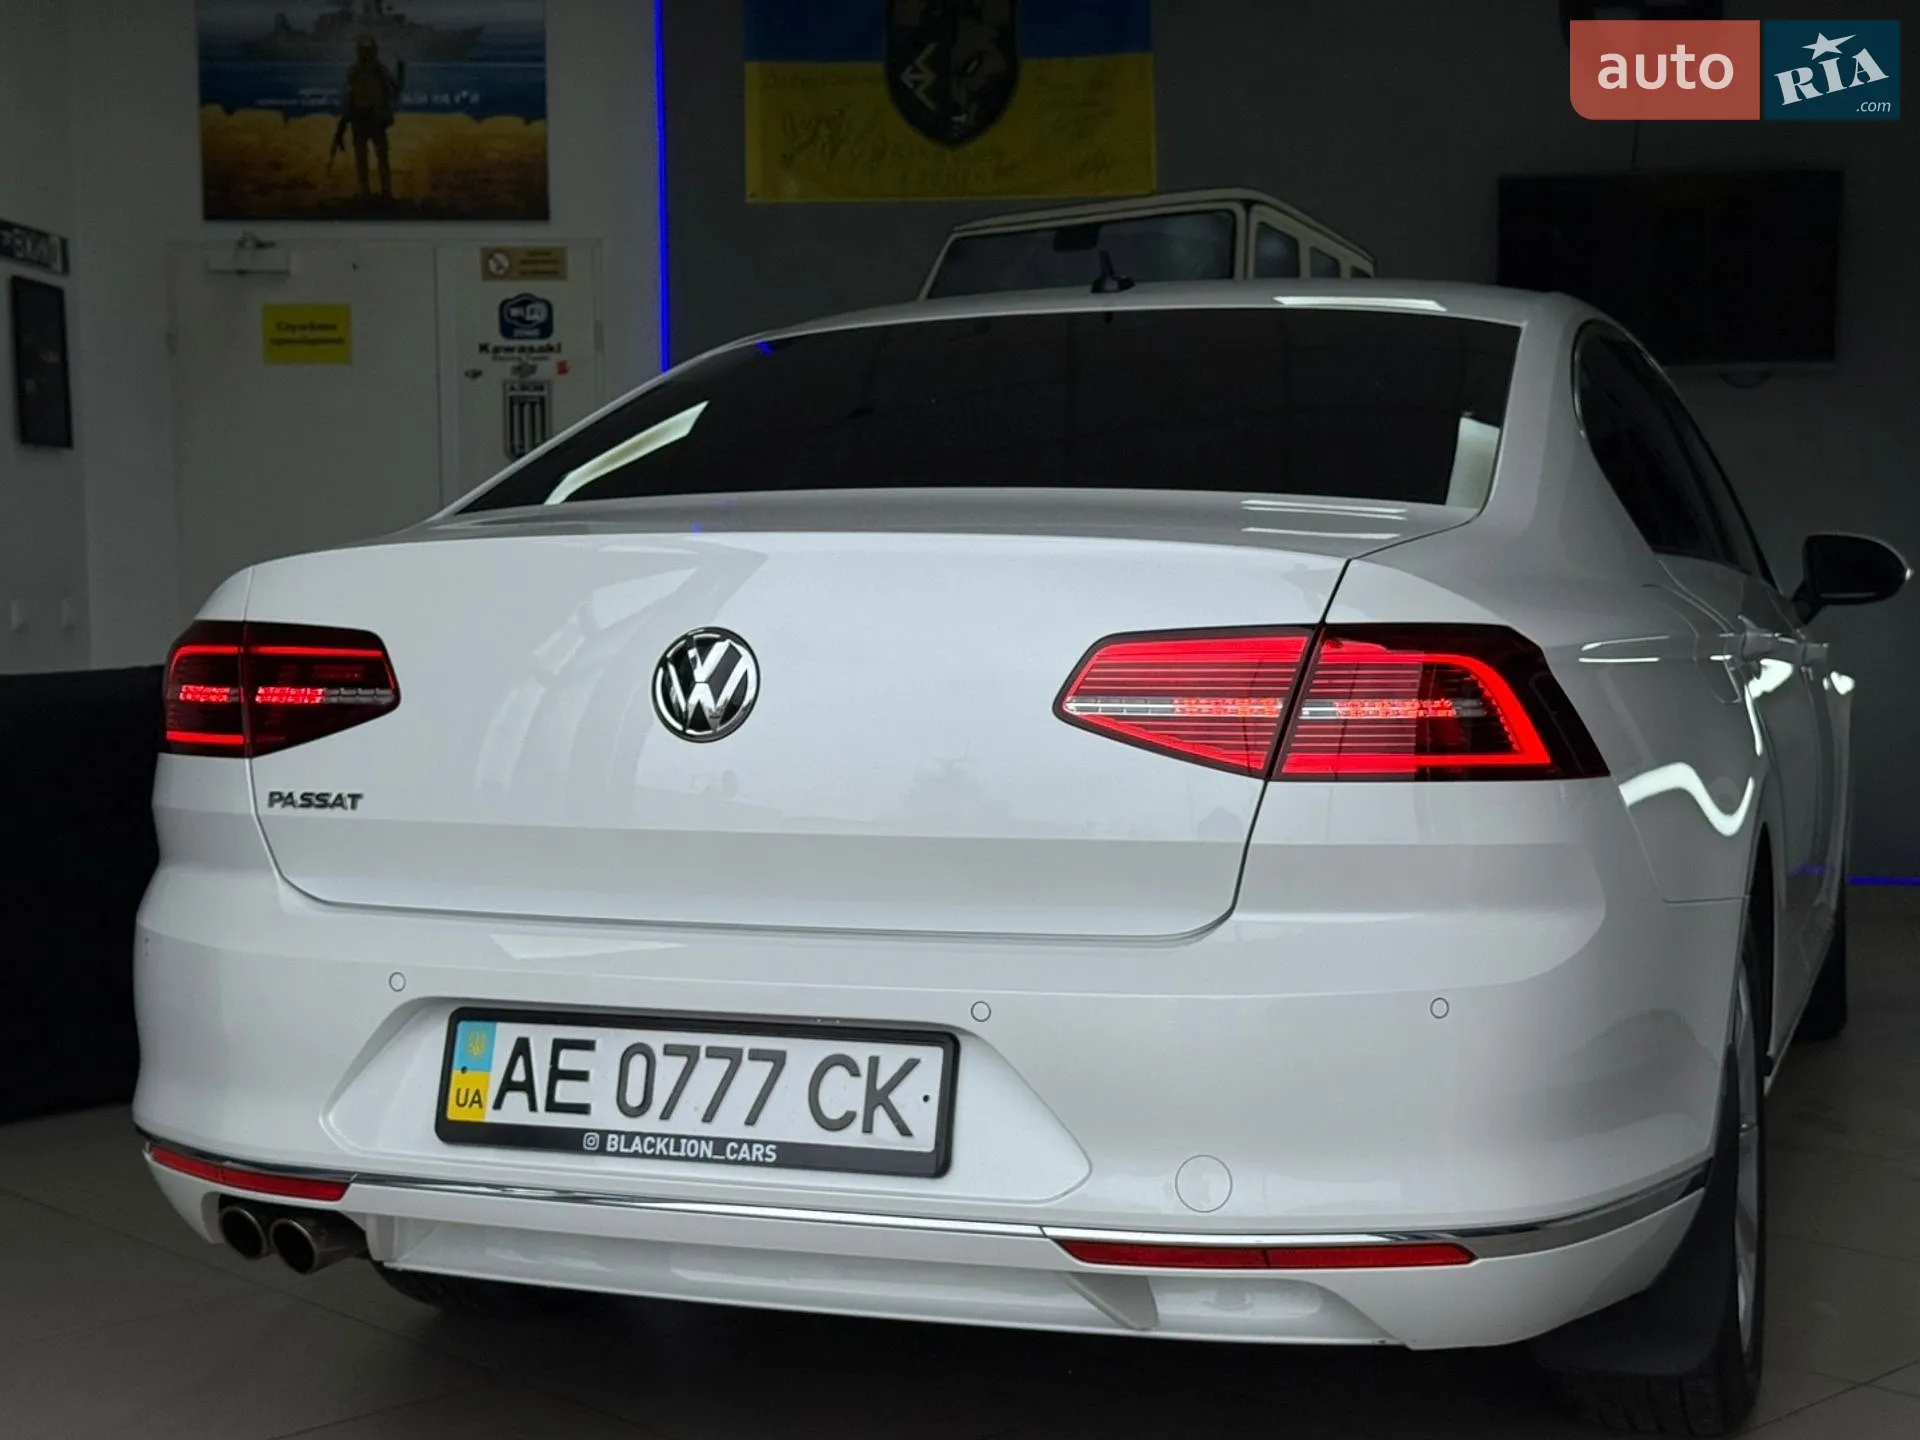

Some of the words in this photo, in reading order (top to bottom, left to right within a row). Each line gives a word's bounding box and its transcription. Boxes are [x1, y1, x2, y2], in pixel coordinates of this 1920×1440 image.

[267, 790, 364, 811] PASSAT
[455, 1087, 483, 1109] UA
[492, 1036, 597, 1115] AE
[616, 1042, 787, 1126] 0777
[808, 1053, 921, 1137] CK
[606, 1133, 777, 1163] BLACKLION_CARS
